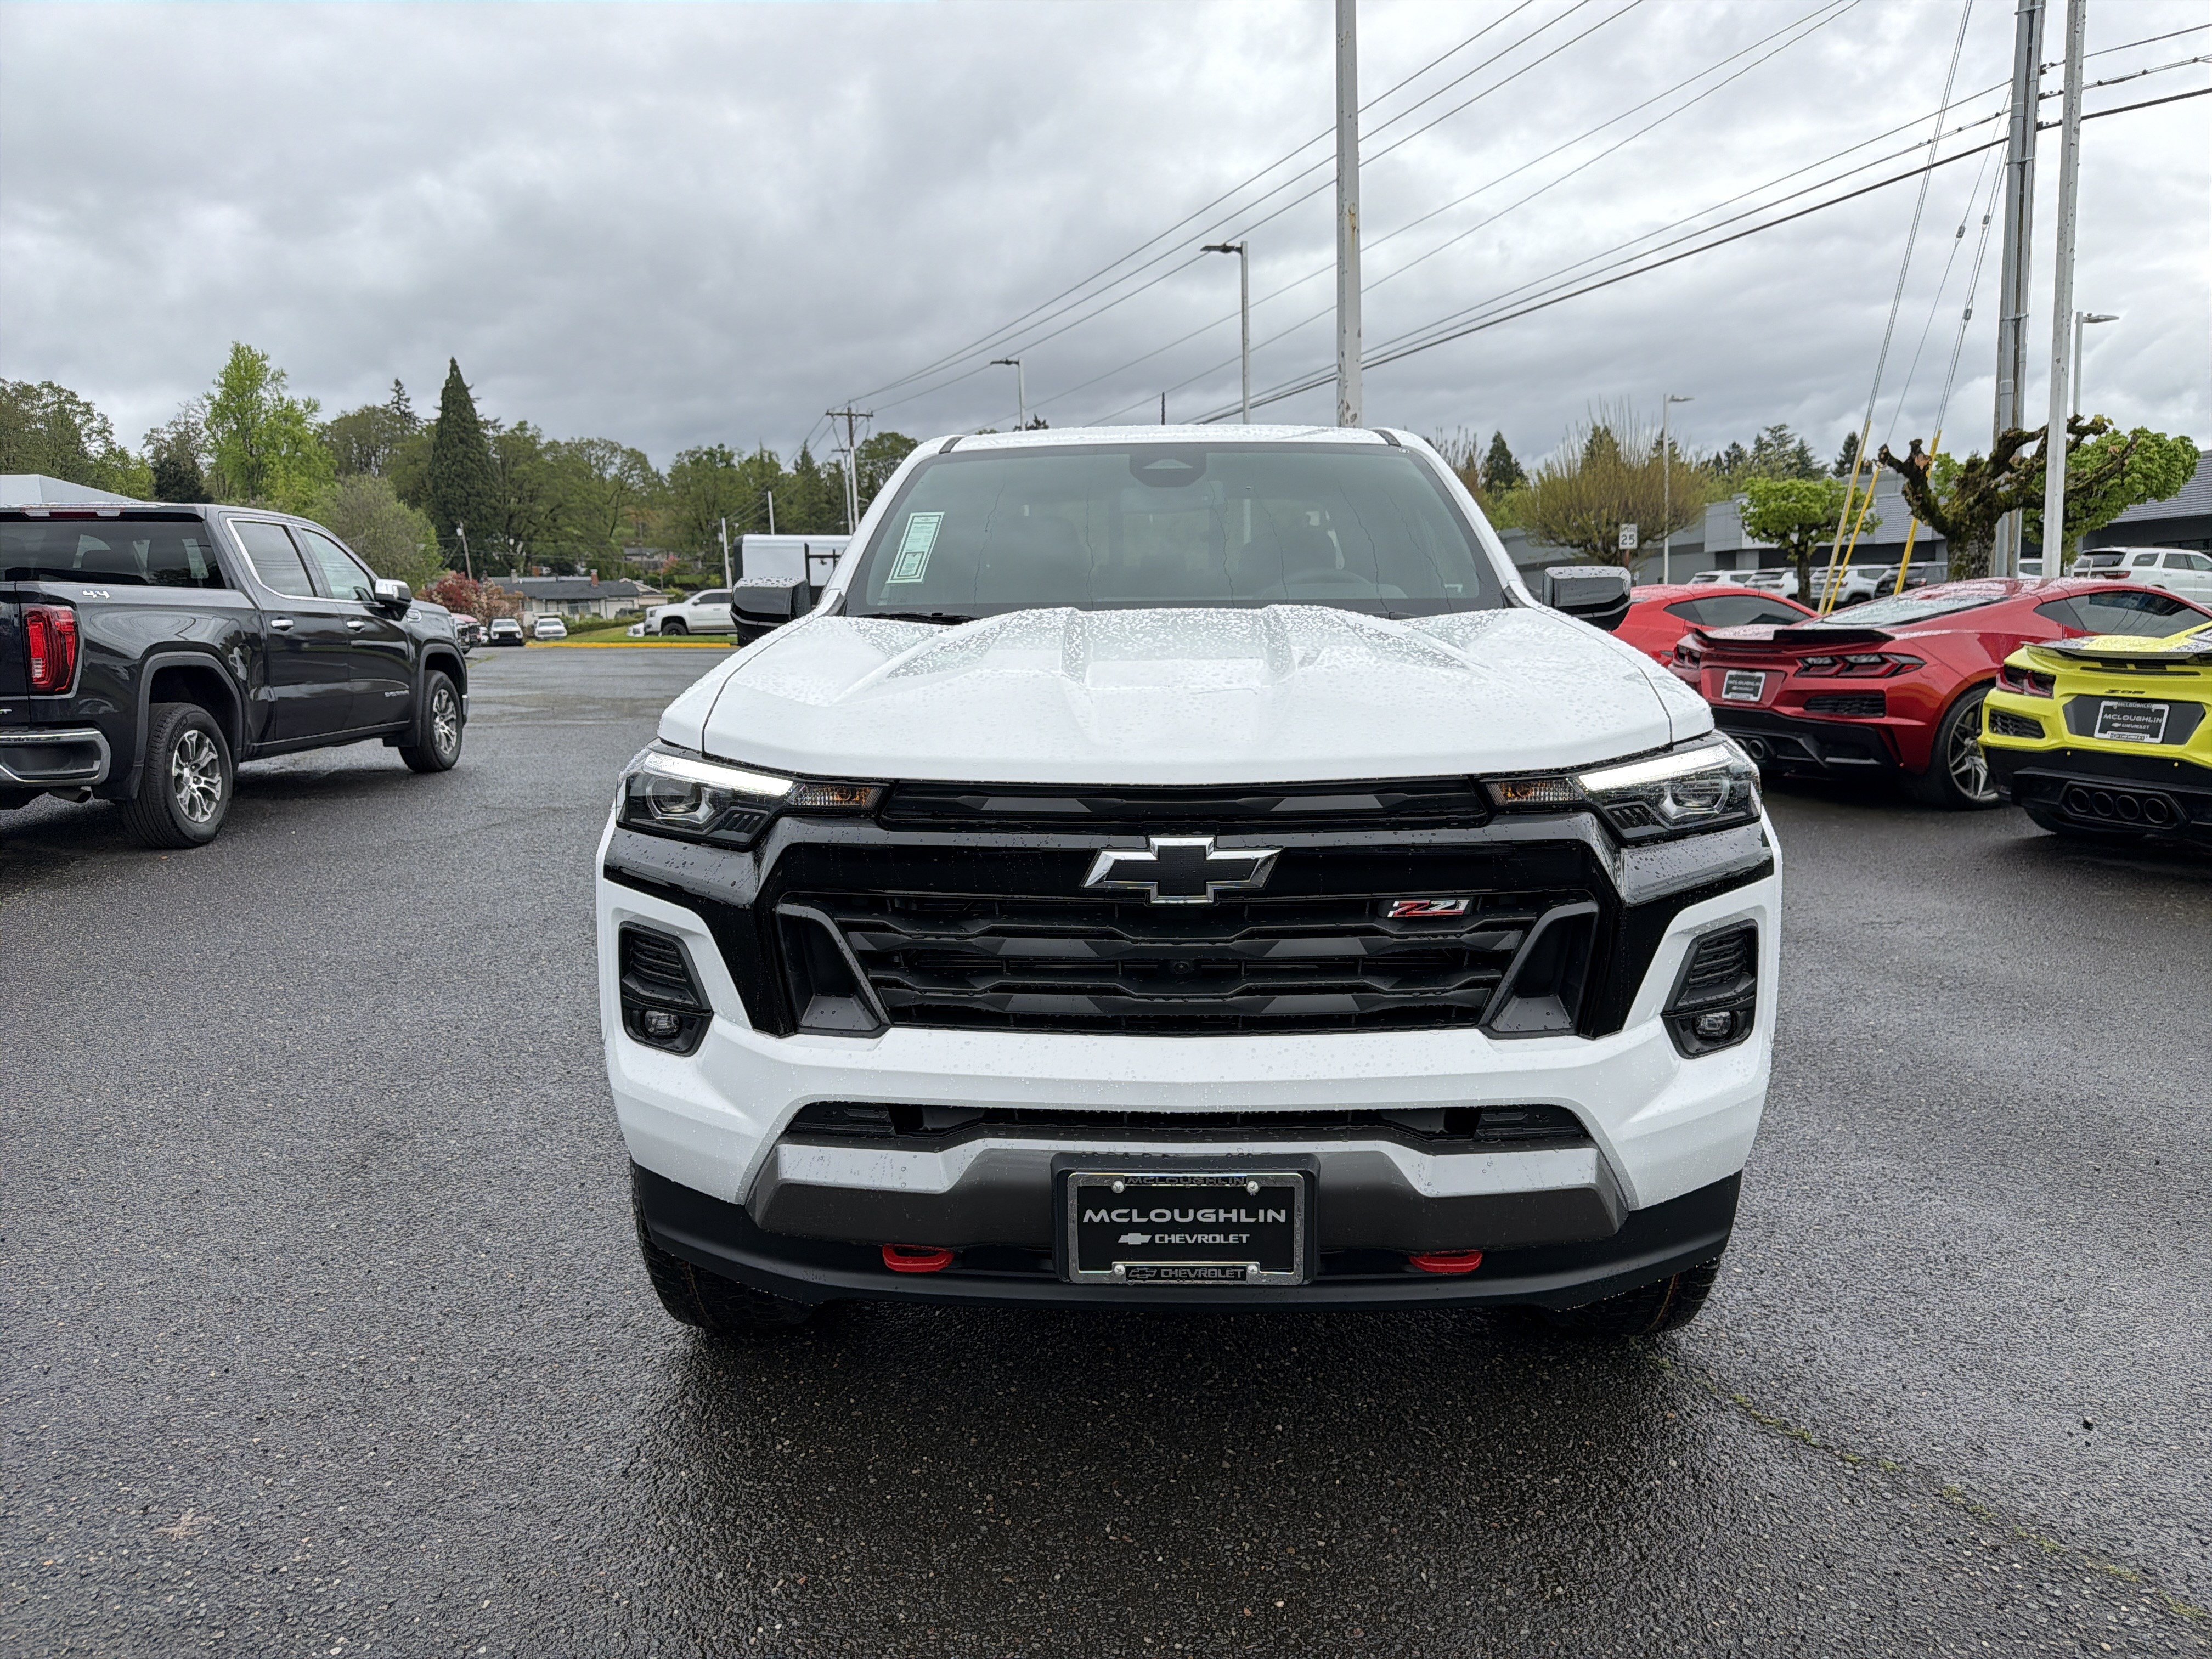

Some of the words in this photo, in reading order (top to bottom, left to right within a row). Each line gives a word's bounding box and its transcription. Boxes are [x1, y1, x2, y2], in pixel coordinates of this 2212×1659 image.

[1621, 534, 1635, 545] 25
[2103, 714, 2163, 723] MCLOUGHLIN
[1387, 900, 1470, 917] Z71
[1127, 1177, 1245, 1185] MCLOUGHLIN
[1083, 1209, 1286, 1223] MCLOUGHLIN
[1155, 1234, 1250, 1244] CHEVROLET
[1160, 1269, 1245, 1278] CHEVROLET
